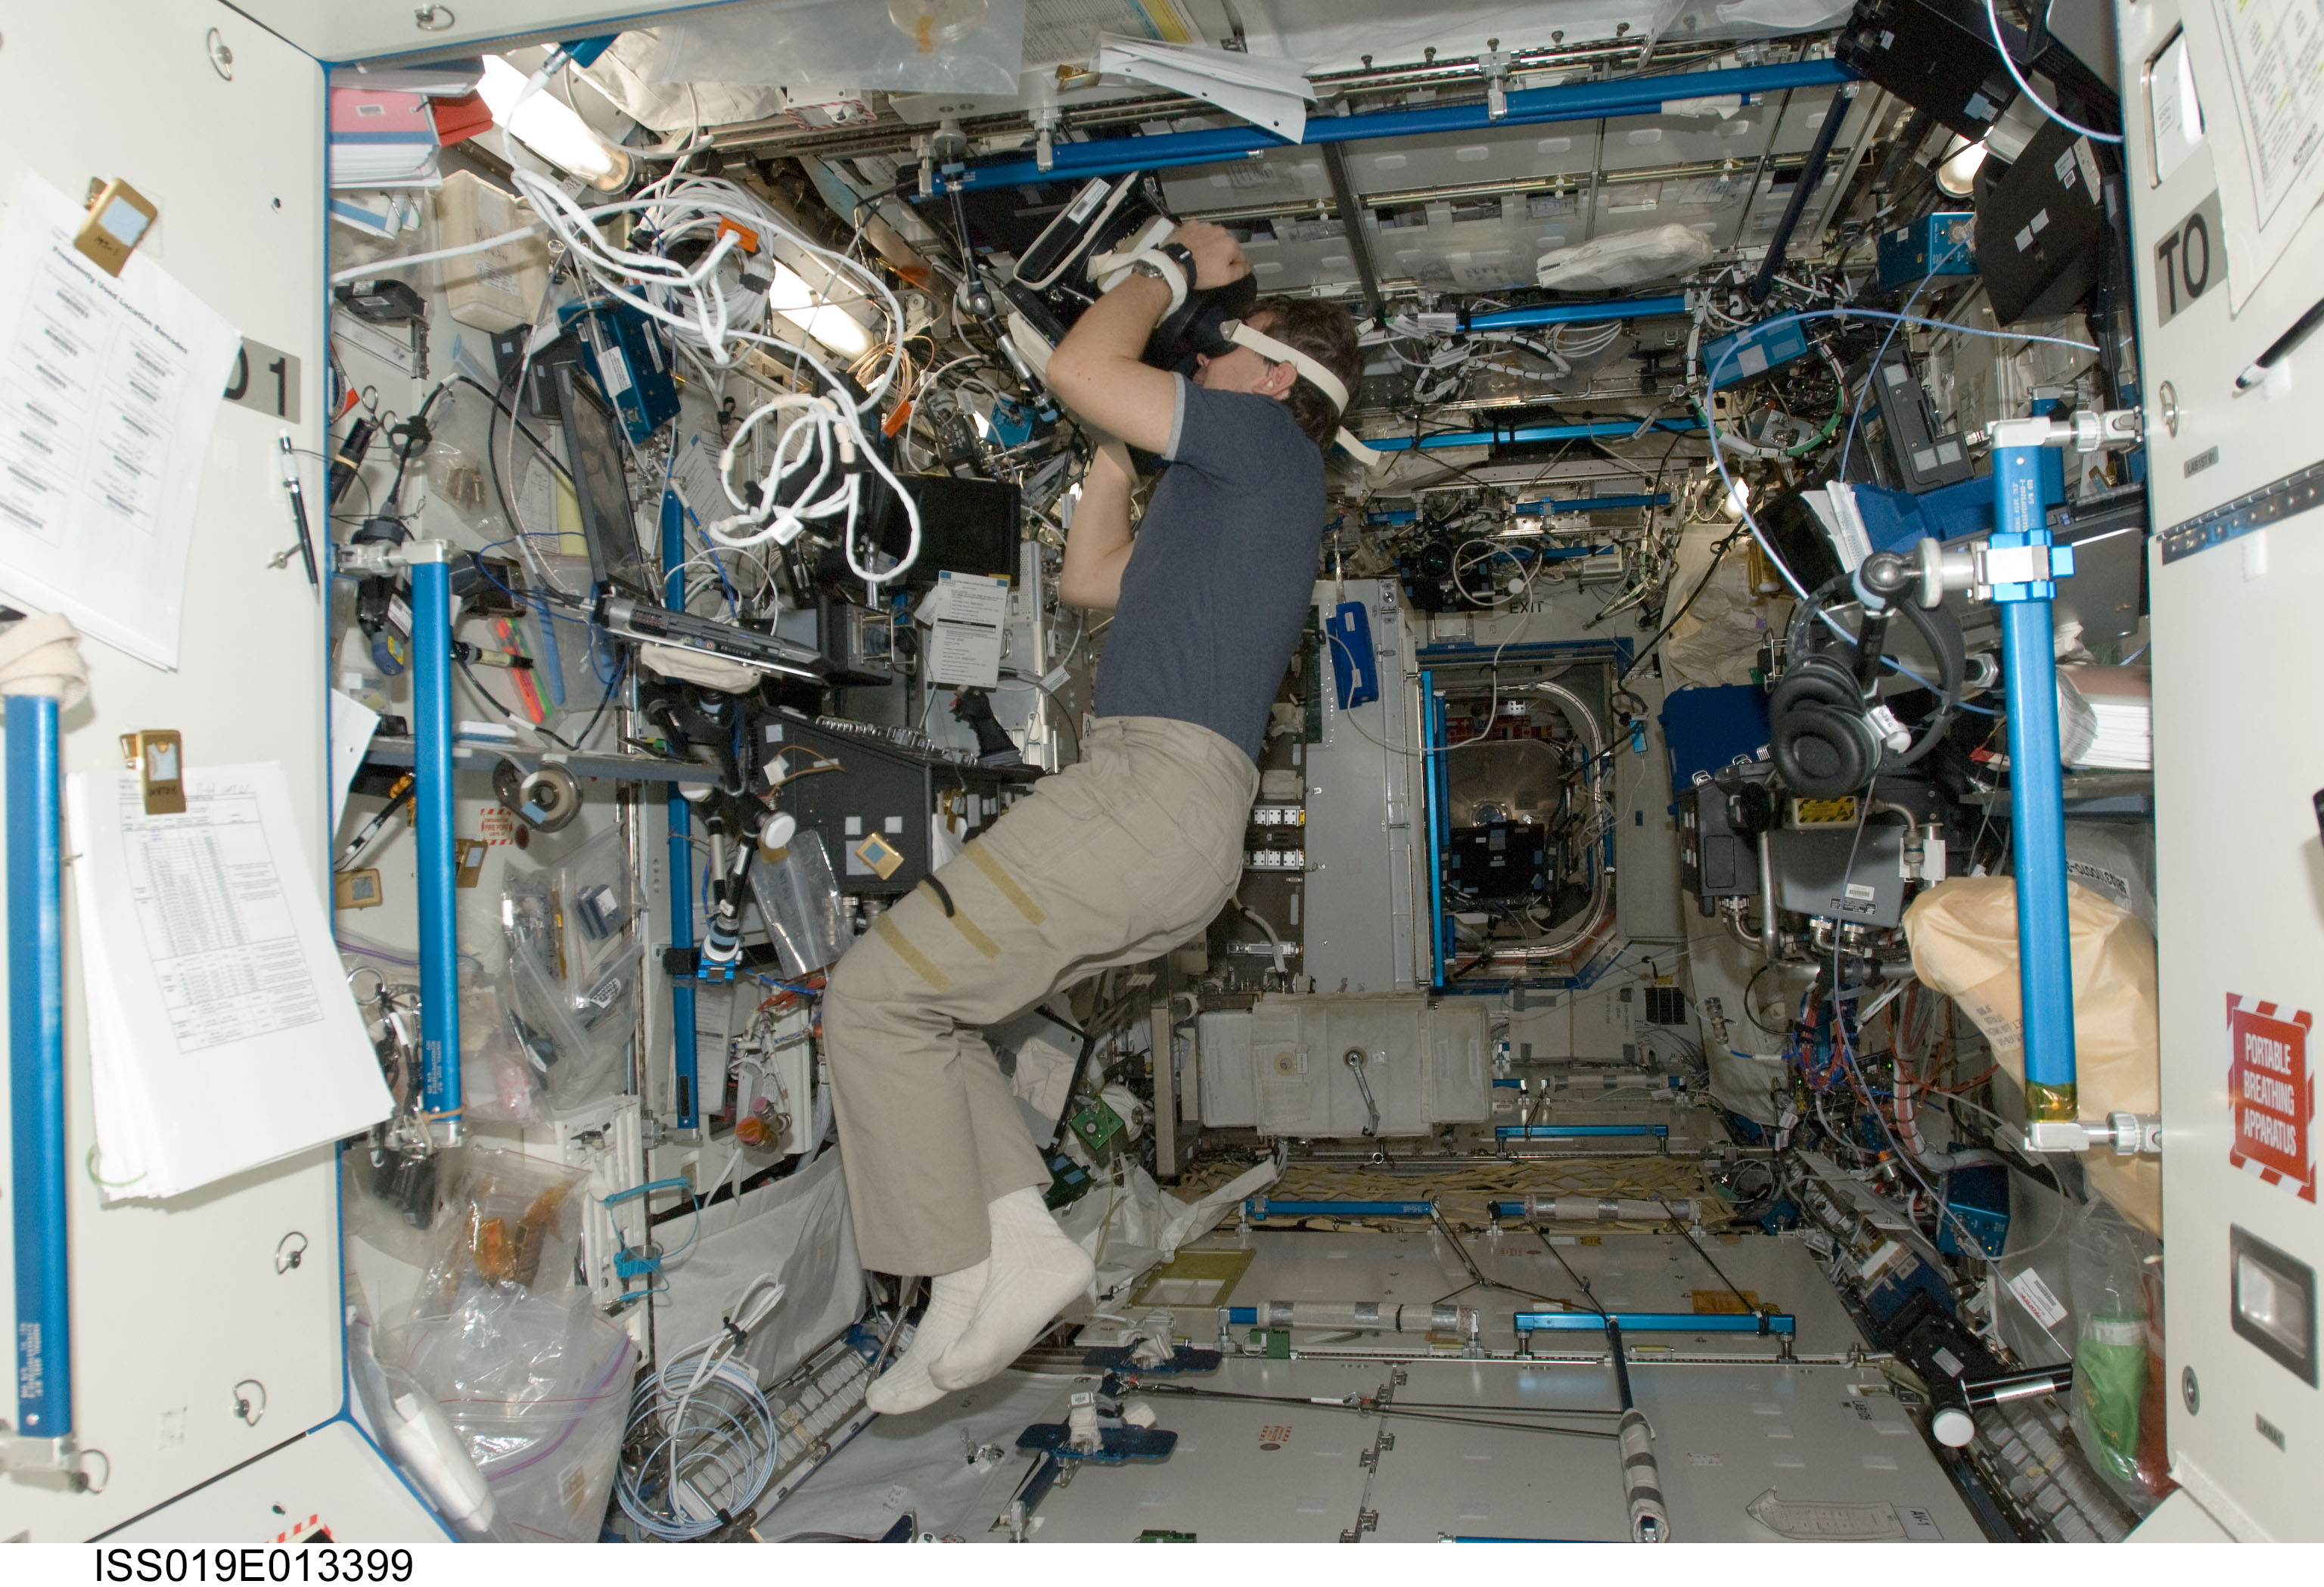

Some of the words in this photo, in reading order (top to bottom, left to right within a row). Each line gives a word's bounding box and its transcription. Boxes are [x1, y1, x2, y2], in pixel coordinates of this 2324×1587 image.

[2158, 213, 2210, 315] TO
[119, 297, 153, 327] Location
[268, 356, 286, 418] 1
[1509, 601, 1544, 613] EXIT
[2245, 1032, 2291, 1076] PORTABLE
[2243, 1069, 2295, 1116] BREATHING
[2244, 1107, 2297, 1157] APPARATUS
[1910, 1510, 1930, 1526] AV-1
